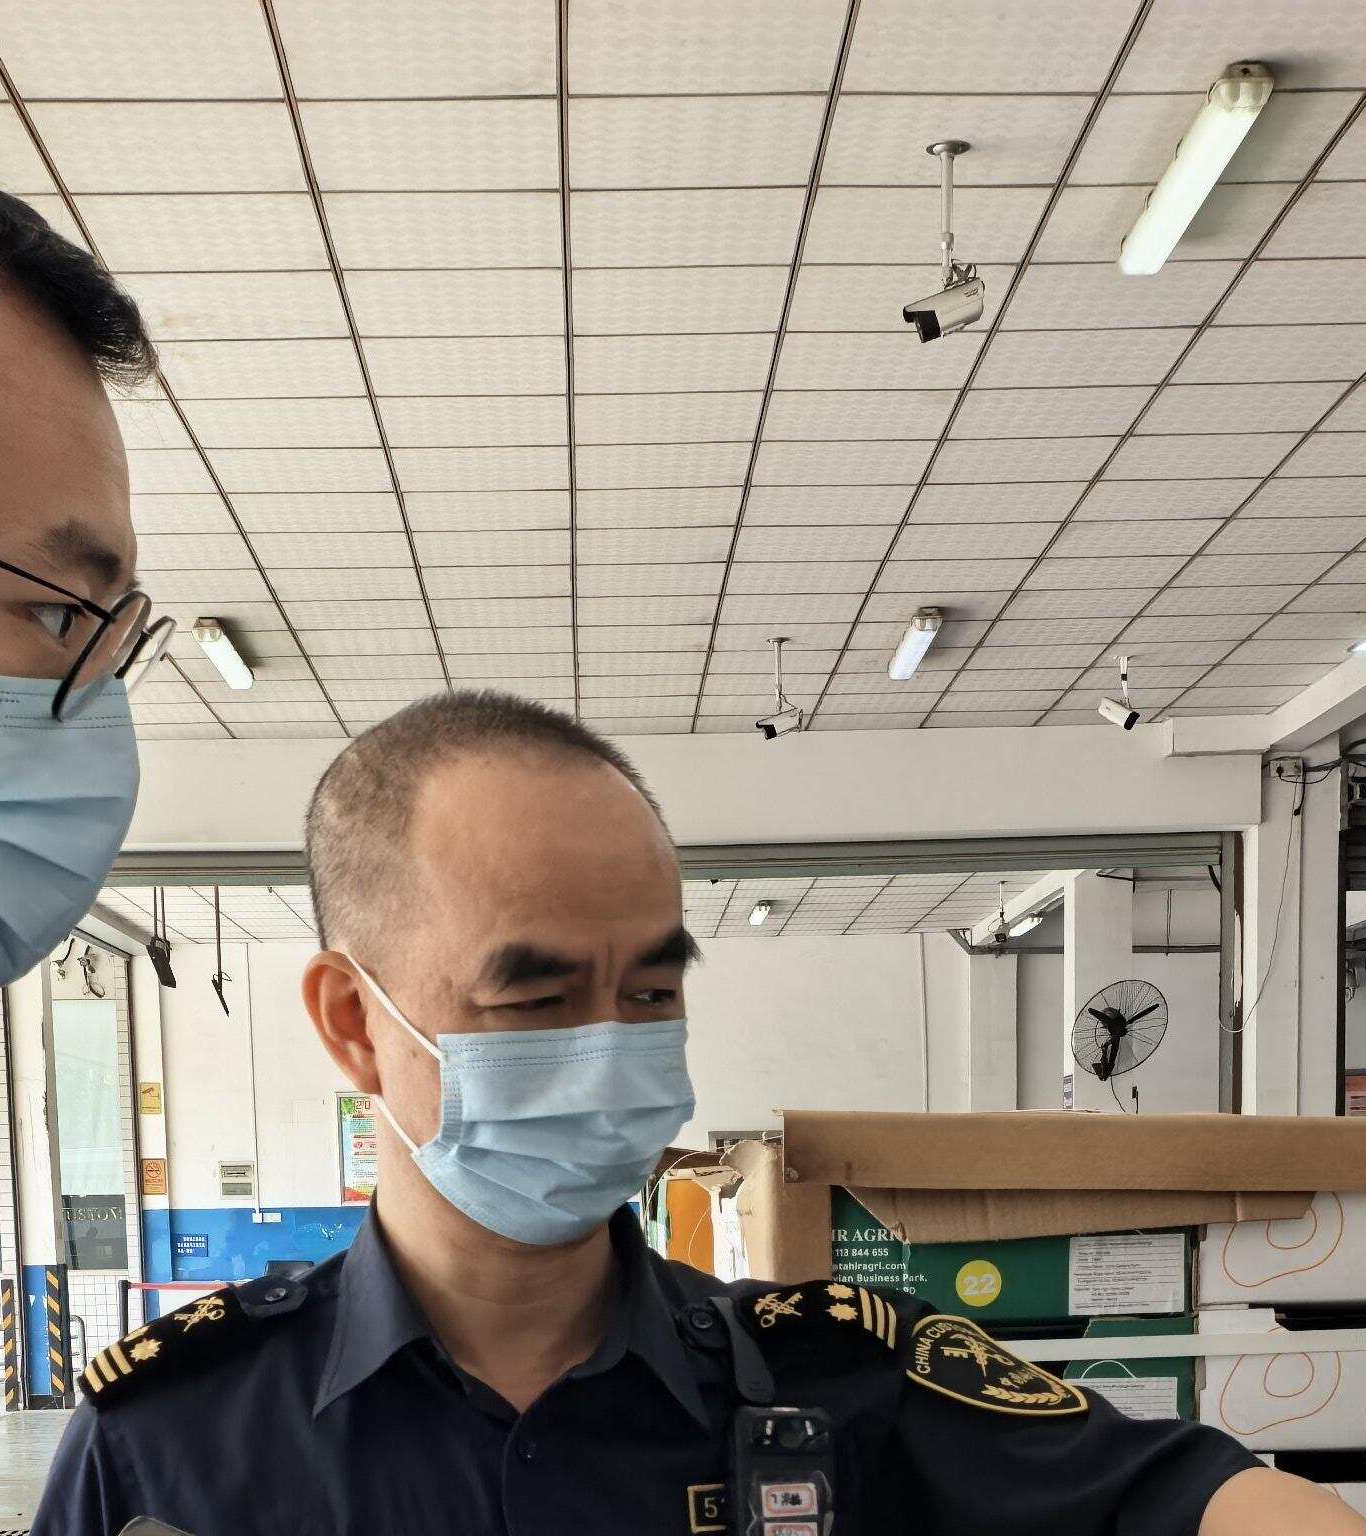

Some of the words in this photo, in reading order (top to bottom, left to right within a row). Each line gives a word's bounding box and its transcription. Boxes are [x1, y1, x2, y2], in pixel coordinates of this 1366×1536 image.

[851, 1248, 870, 1257] 844
[871, 1248, 889, 1257] 655
[856, 1273, 899, 1283] Business
[963, 1273, 997, 1297] 22
[915, 1337, 935, 1374] CHINA
